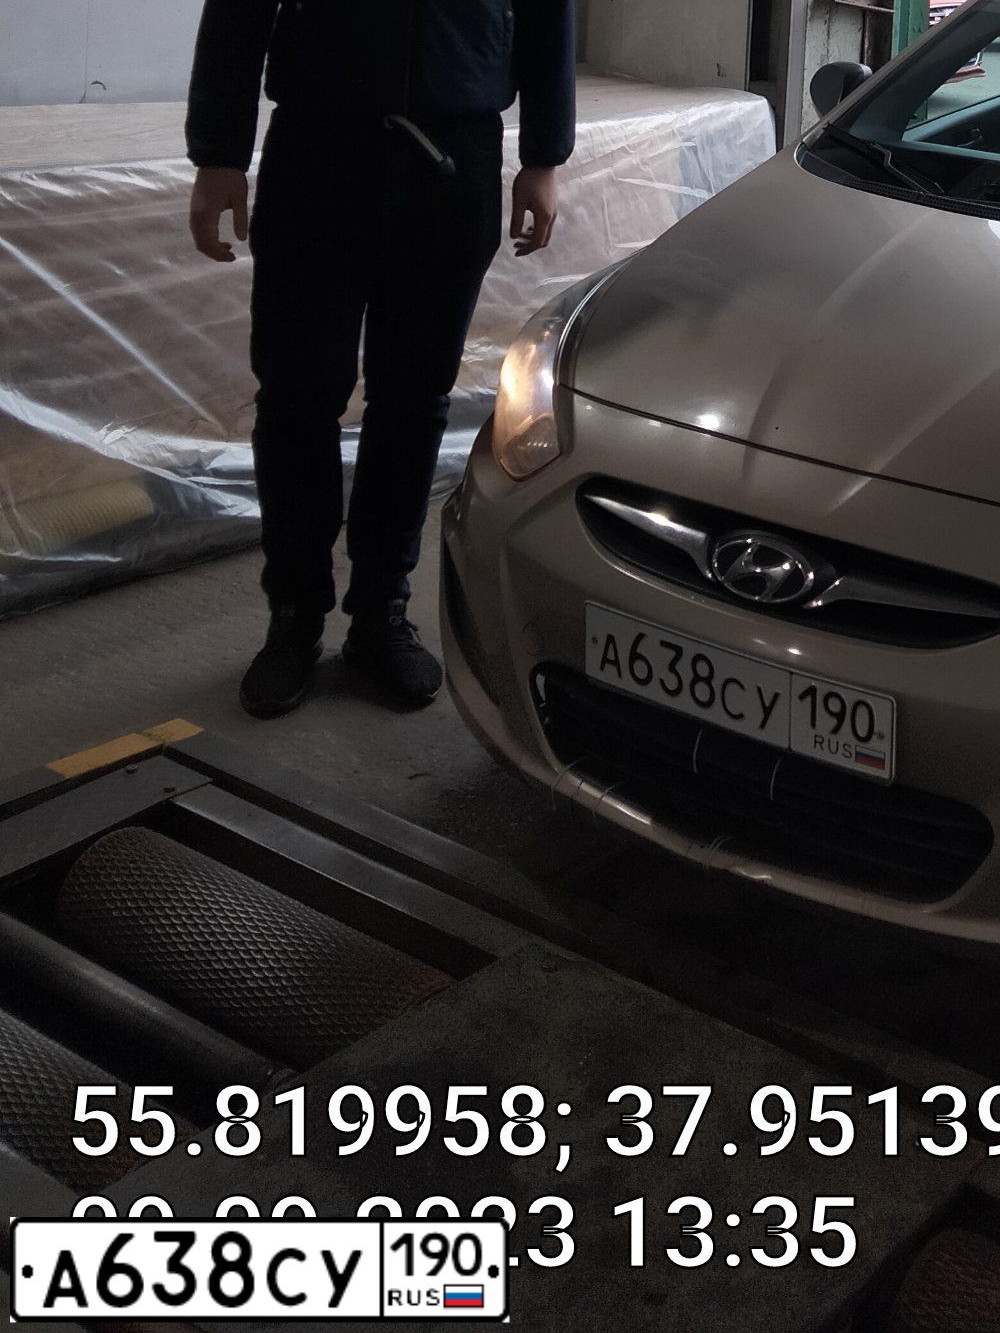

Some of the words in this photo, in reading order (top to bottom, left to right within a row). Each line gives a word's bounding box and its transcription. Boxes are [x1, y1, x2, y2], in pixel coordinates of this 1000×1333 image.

[599, 632, 780, 730] А638СУ
[798, 682, 875, 743] 190
[813, 734, 853, 759] RUS
